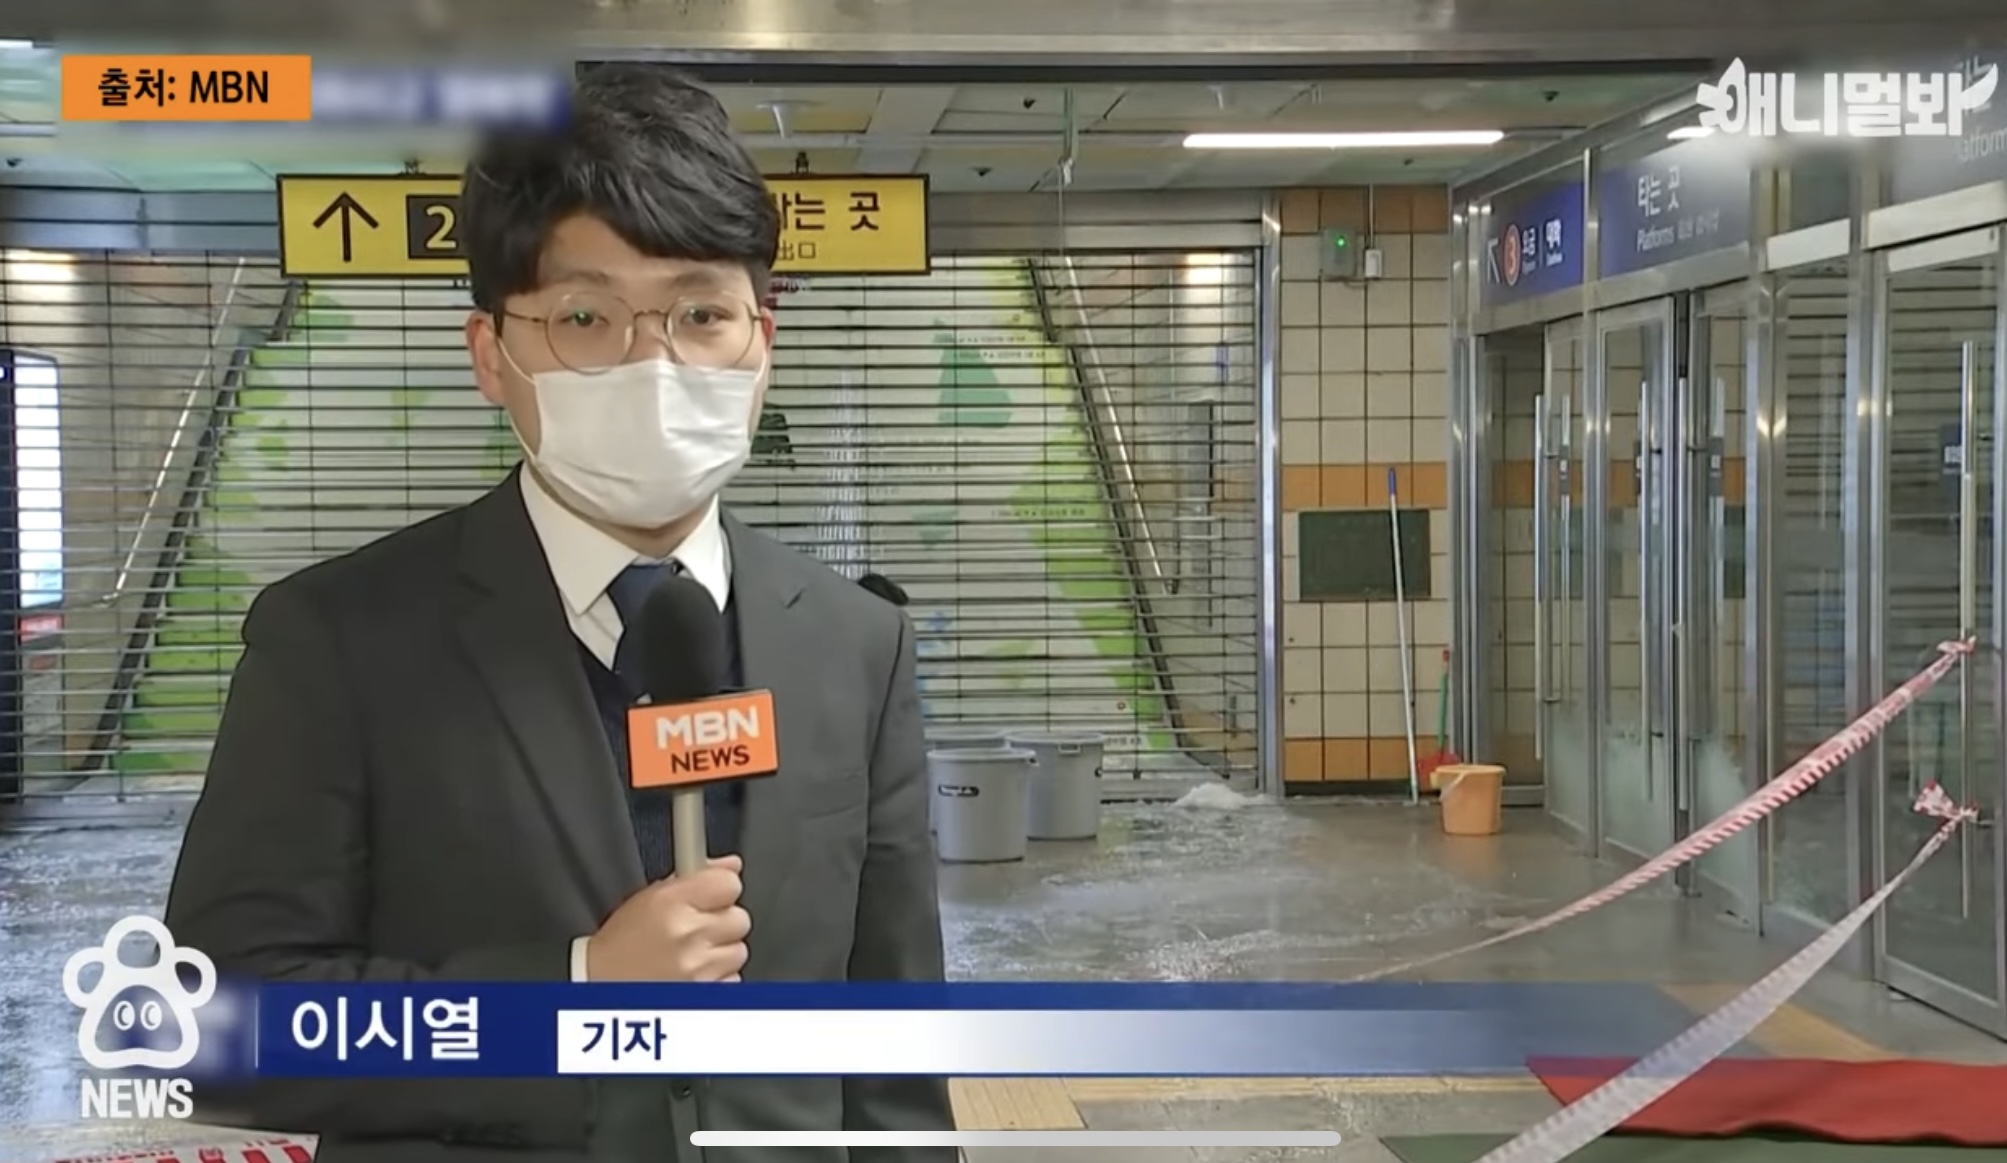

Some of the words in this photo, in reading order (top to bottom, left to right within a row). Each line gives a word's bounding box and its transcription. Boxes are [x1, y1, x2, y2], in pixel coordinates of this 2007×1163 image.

[848, 191, 880, 231] 곳
[1638, 174, 1661, 217] 타는
[1667, 164, 1680, 212] 곳
[425, 204, 457, 249] 2
[655, 704, 760, 751] MBN
[671, 744, 751, 774] NEWS
